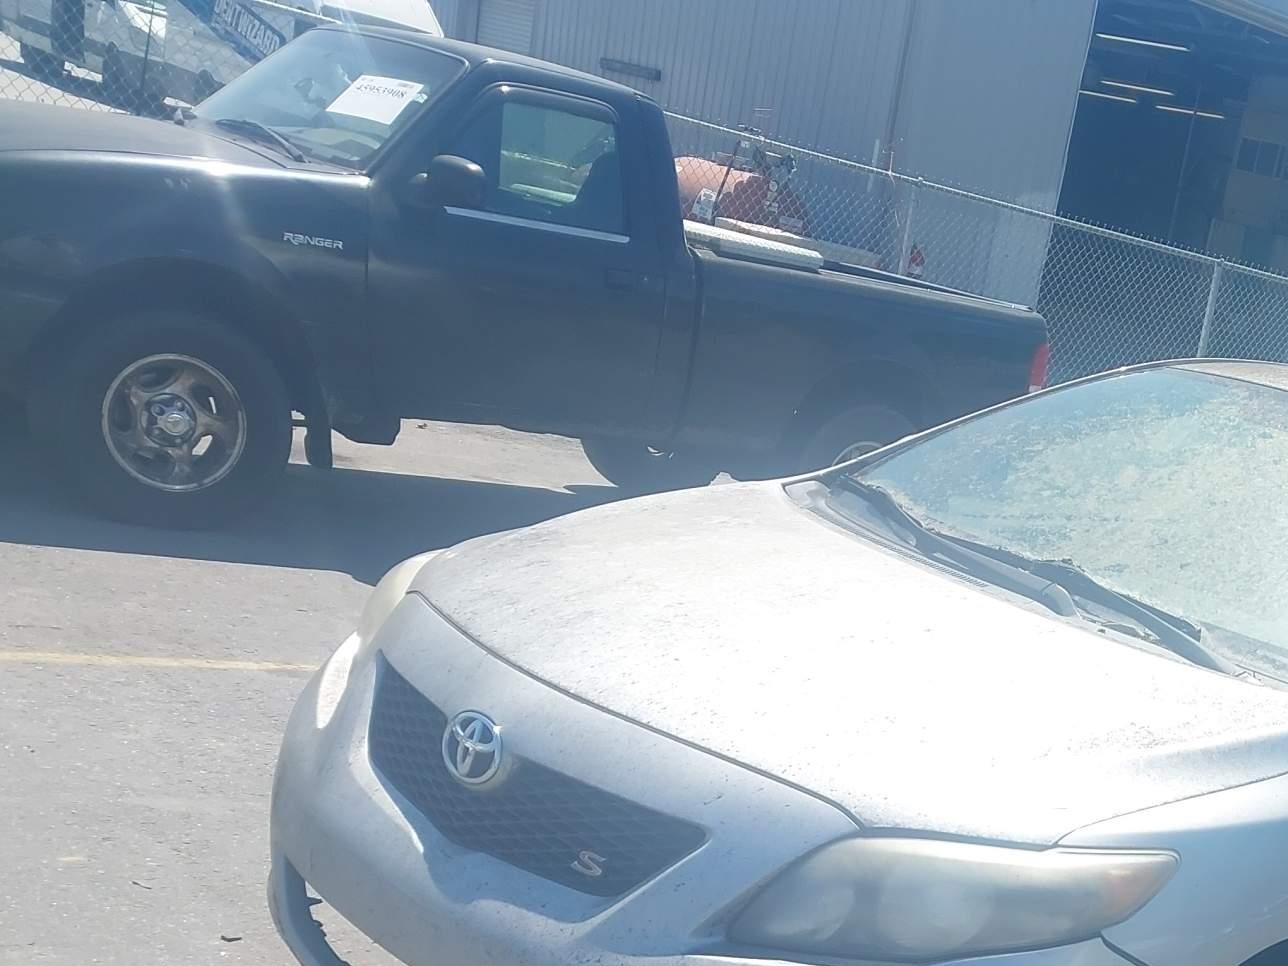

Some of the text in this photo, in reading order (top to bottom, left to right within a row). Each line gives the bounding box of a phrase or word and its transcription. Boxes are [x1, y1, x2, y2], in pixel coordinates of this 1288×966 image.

[238, 7, 281, 55] WIZARD
[283, 232, 344, 250] RANGER
[570, 850, 607, 876] S
